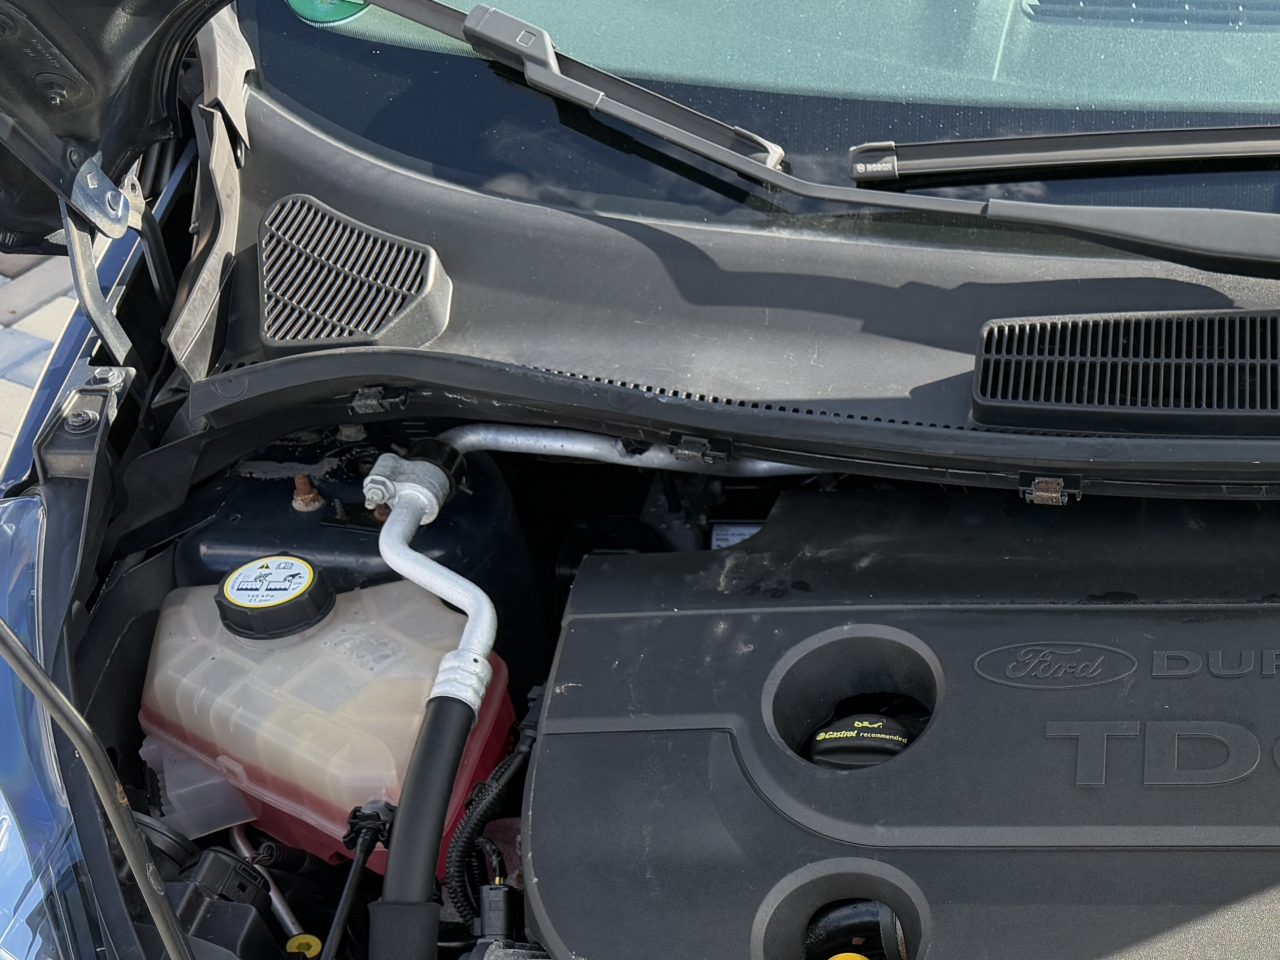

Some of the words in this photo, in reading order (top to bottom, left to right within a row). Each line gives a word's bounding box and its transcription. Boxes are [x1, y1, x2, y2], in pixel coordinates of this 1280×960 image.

[1007, 647, 1106, 680] Ford
[825, 730, 858, 740] Castrol
[859, 731, 908, 744] recommended
